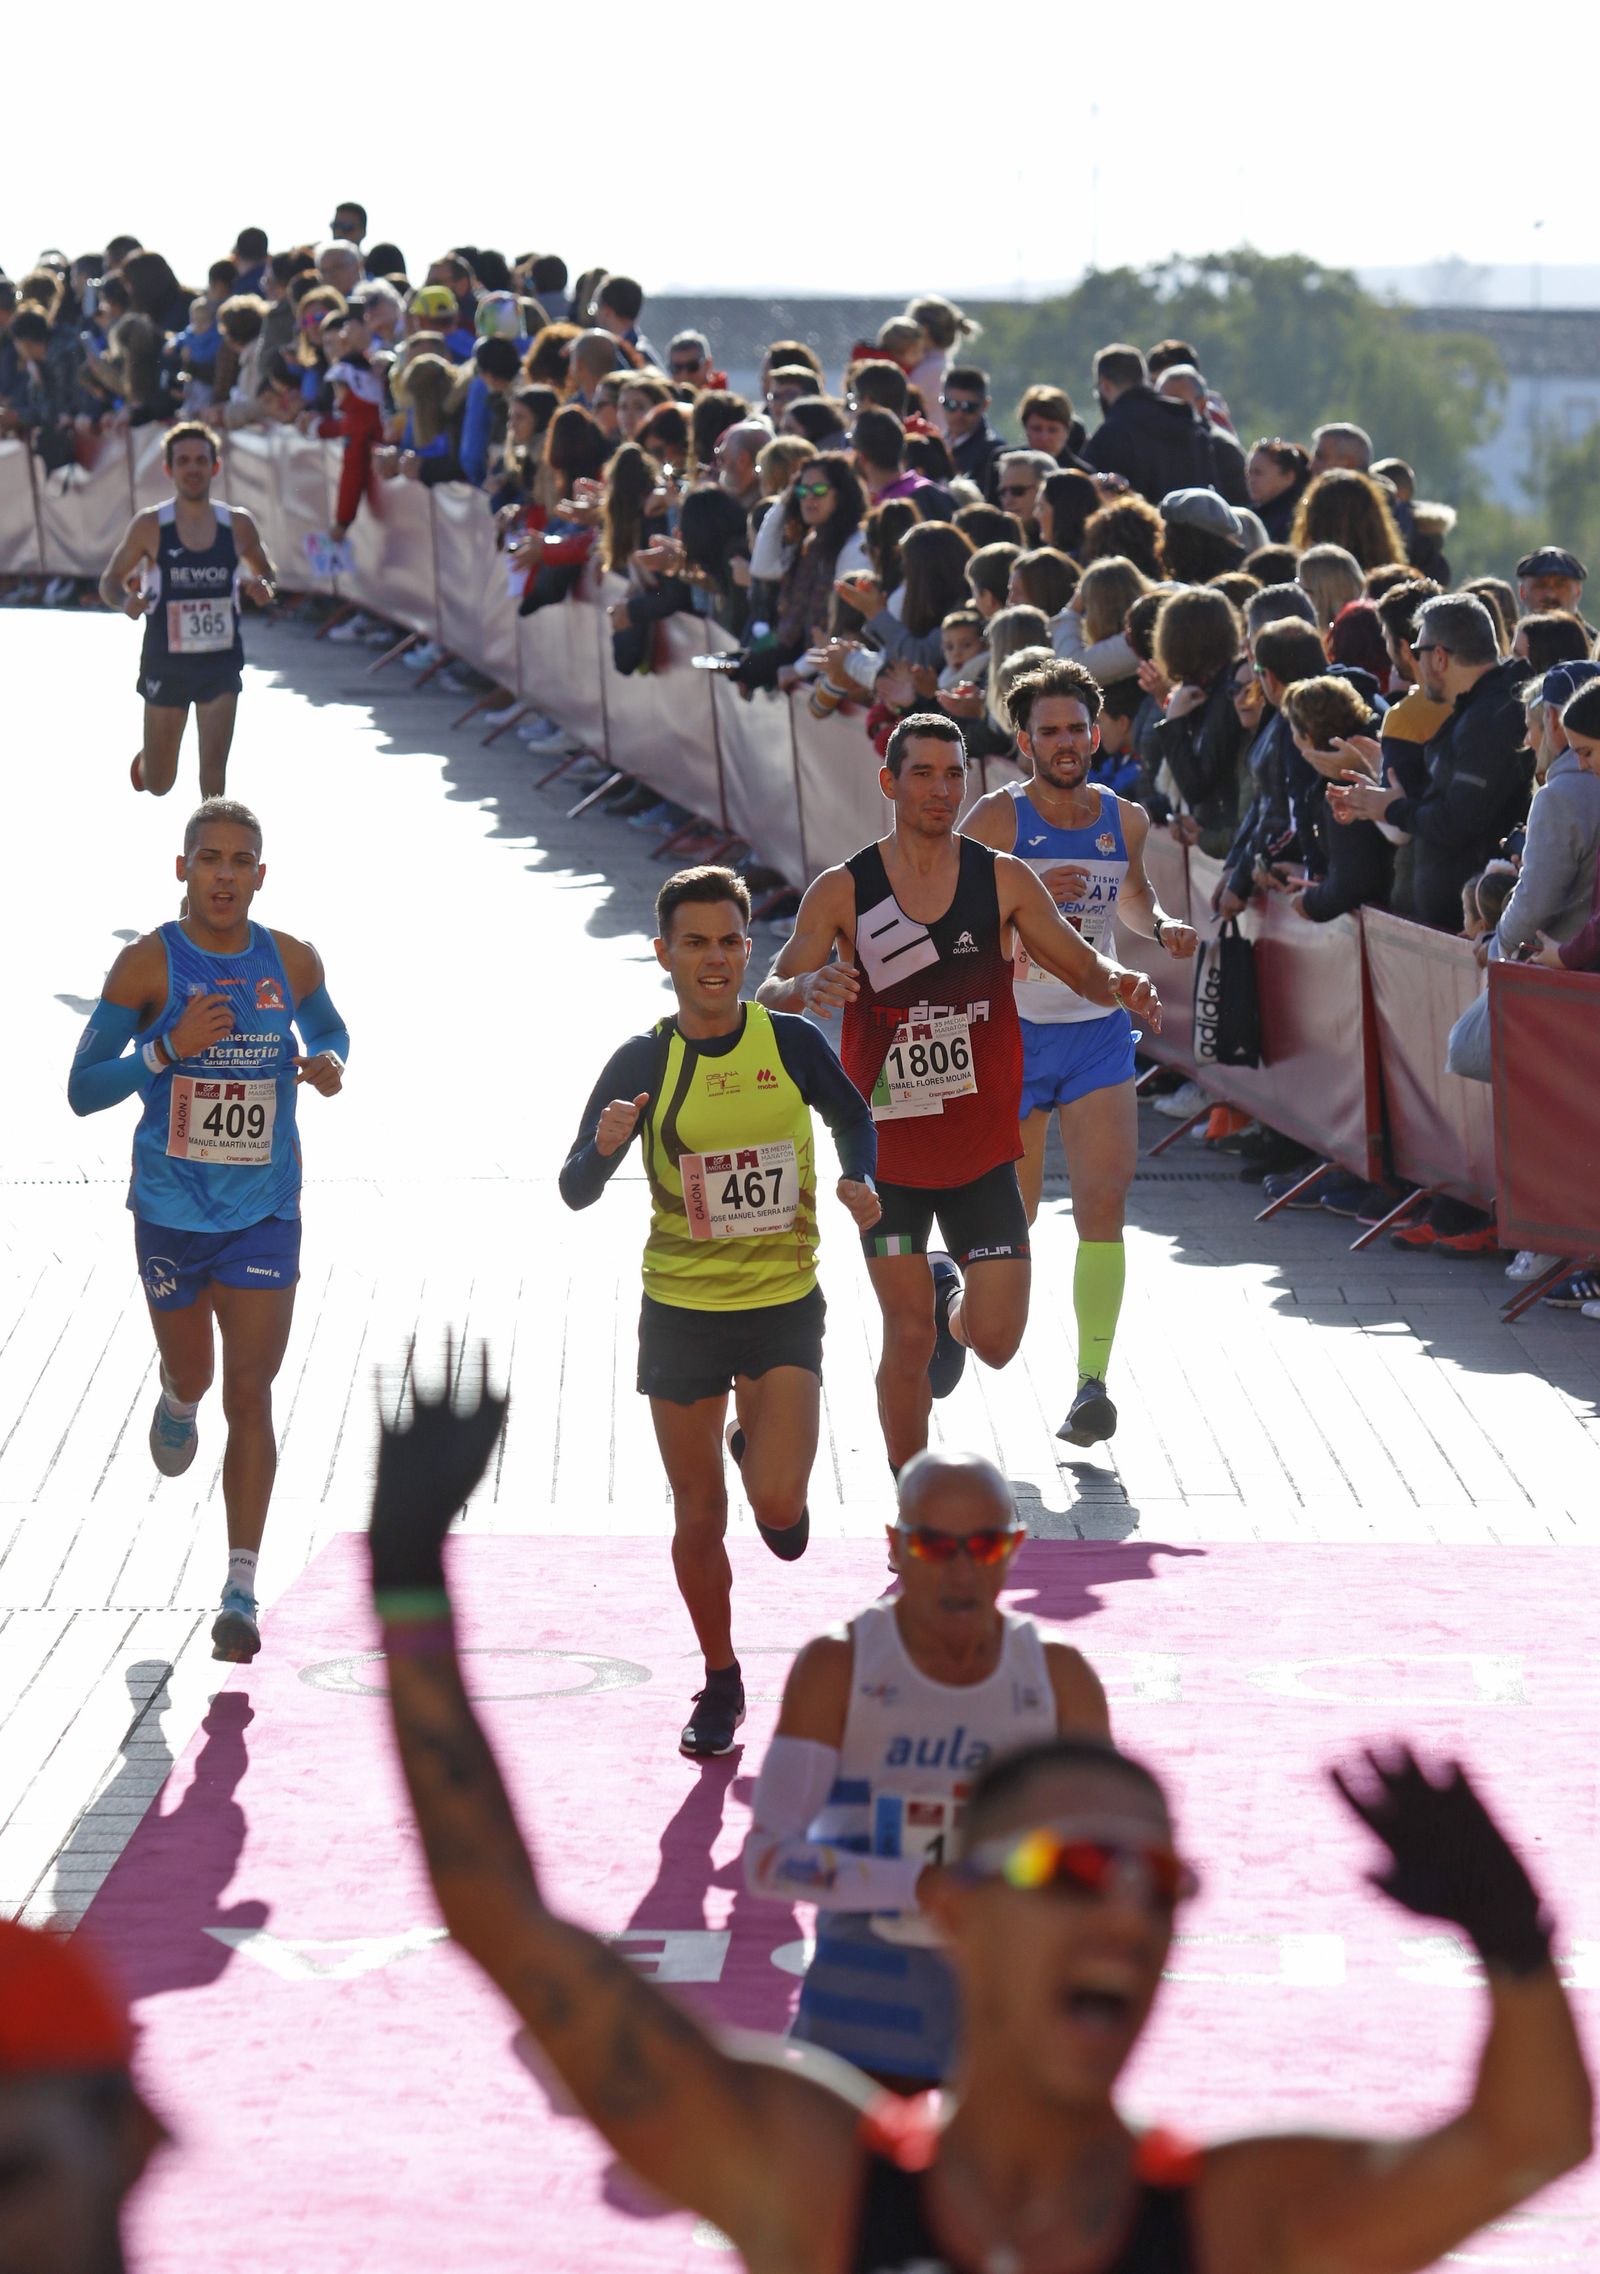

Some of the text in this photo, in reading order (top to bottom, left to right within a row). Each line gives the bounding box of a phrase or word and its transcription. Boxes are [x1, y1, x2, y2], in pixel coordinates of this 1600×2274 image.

[189, 612, 225, 636] 365
[1056, 902, 1086, 913] PEN
[1197, 967, 1221, 1058] adidas
[216, 1032, 281, 1043] mercado
[207, 1046, 279, 1058] Ternerita
[889, 1037, 969, 1080] 1806
[888, 1071, 972, 1090] ISMAEL FLORES MOLINA
[180, 1094, 188, 1102] 2
[202, 1102, 266, 1140] 409
[188, 1136, 218, 1148] MANUEL
[769, 1143, 792, 1153] MEDIA
[721, 1167, 784, 1210] 467
[710, 1214, 727, 1223] JOSE
[727, 1211, 756, 1221] MANUEL
[756, 1207, 782, 1217] SIERRA
[885, 1726, 996, 1771] aula
